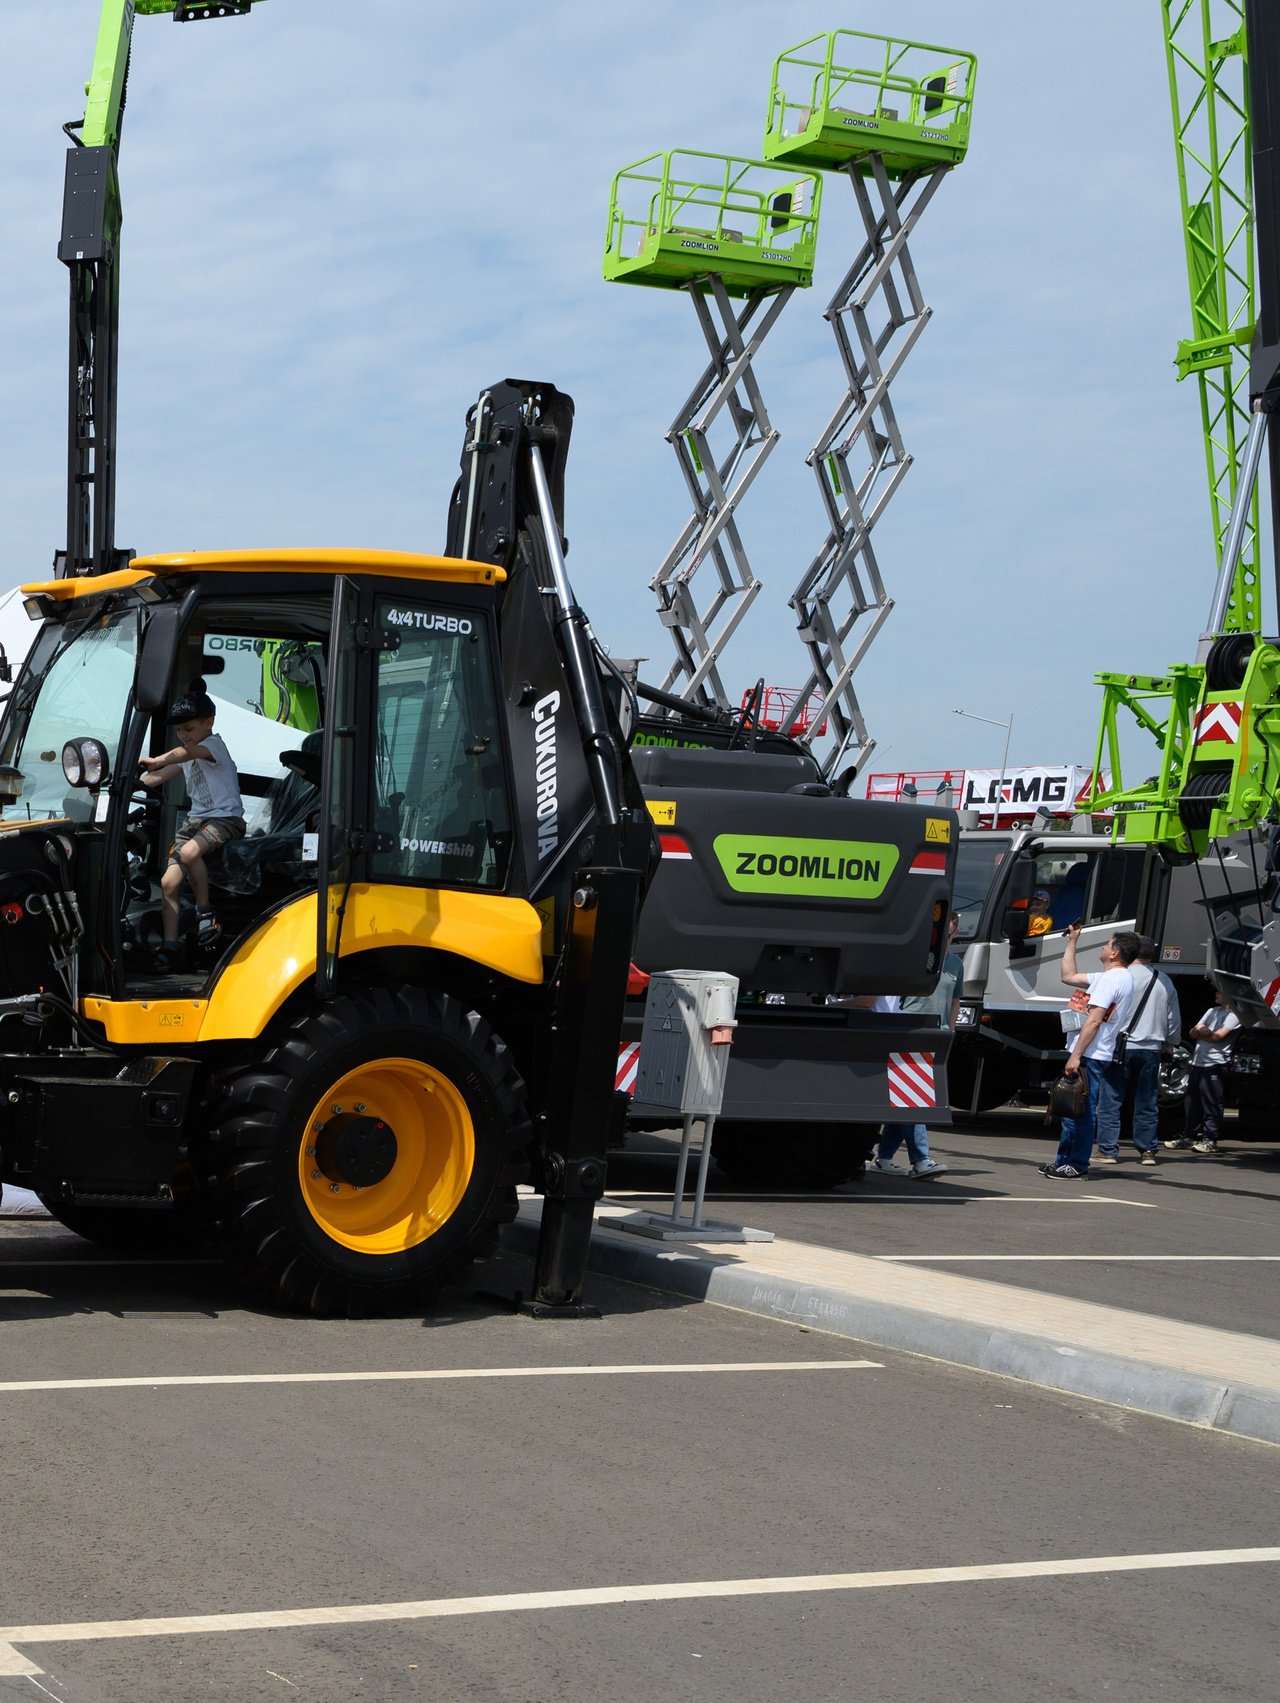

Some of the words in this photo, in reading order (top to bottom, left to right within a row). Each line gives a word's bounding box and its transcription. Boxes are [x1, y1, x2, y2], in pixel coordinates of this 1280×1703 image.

[843, 117, 879, 130] ZOOMLION
[920, 130, 949, 141] ZS1212HD
[680, 240, 719, 251] ZOOMLION
[761, 251, 792, 262] ZS1012HD
[531, 690, 560, 861] ÇUKUROVA
[735, 852, 881, 882] ZOOMLION
